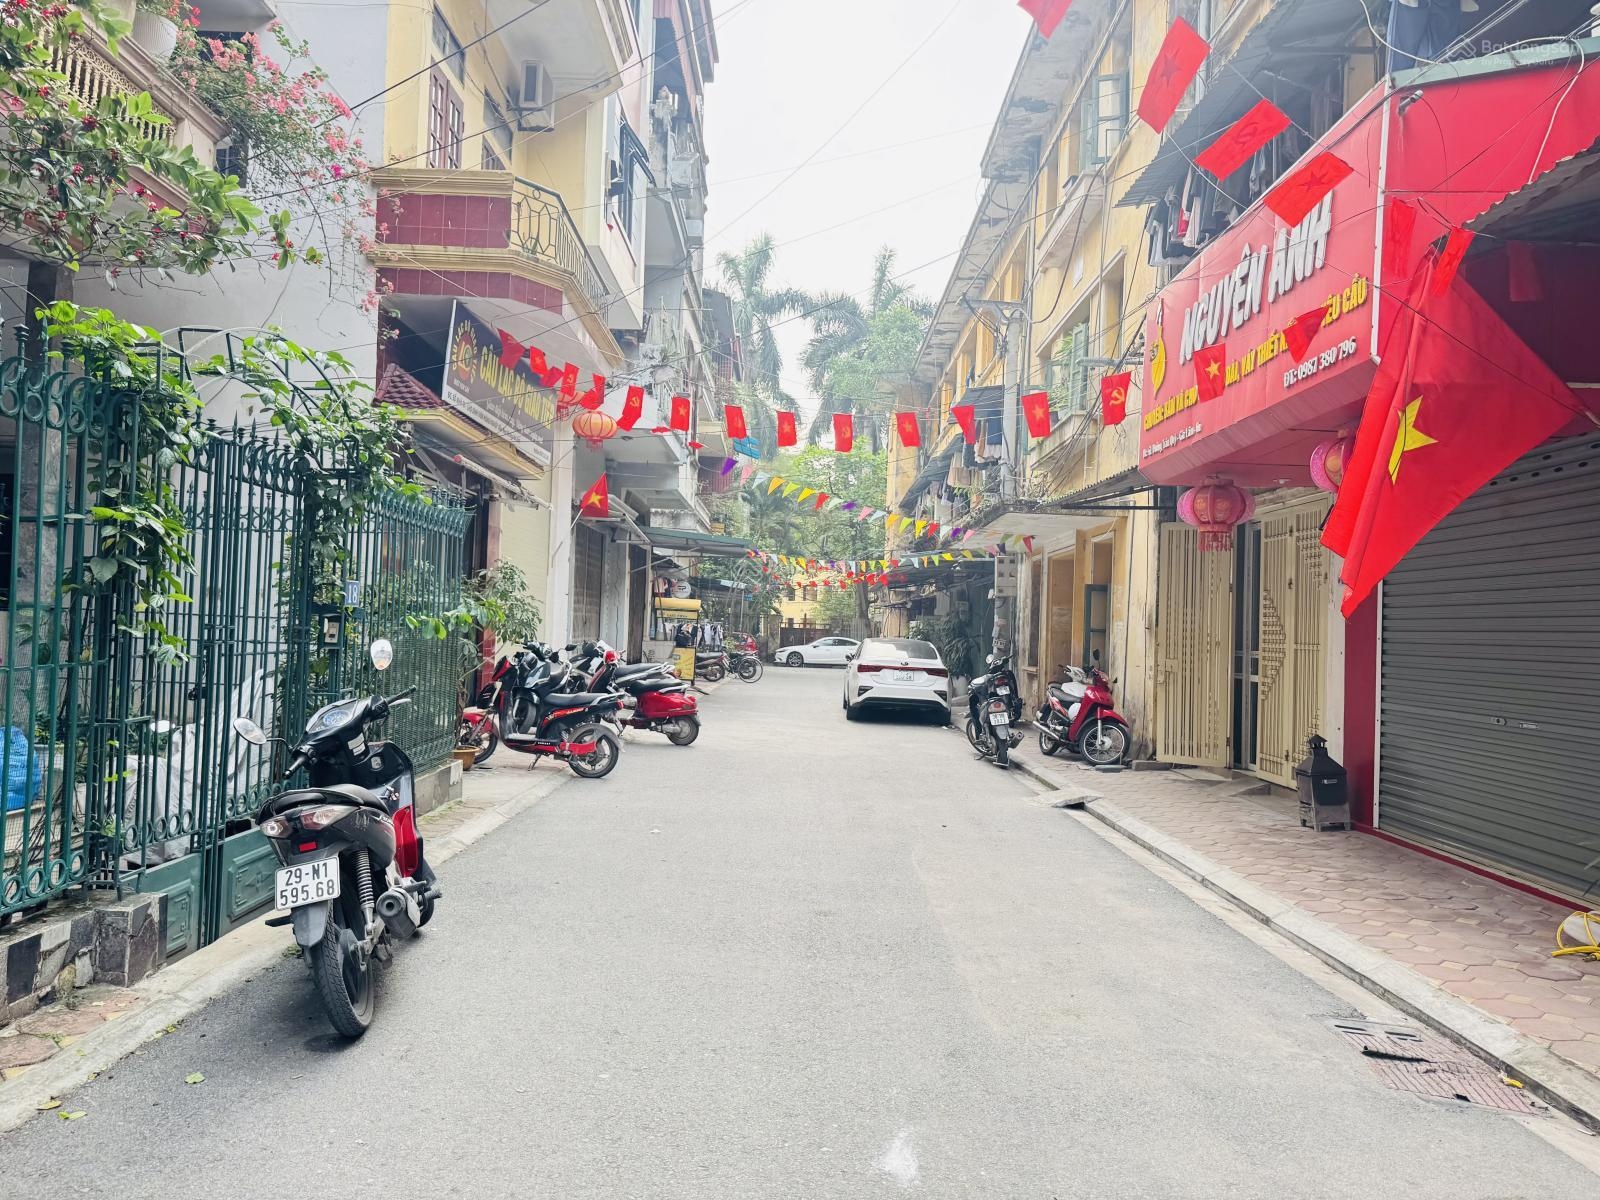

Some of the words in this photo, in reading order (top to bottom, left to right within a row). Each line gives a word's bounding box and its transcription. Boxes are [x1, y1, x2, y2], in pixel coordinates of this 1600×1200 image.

[1180, 243, 1268, 365] NGUYÊN
[1343, 273, 1367, 313] CẦU
[482, 345, 499, 388] CÂU
[1297, 356, 1318, 380] 0987
[1319, 346, 1338, 370] 380
[1338, 336, 1357, 360] 796
[348, 584, 358, 603] 18
[280, 879, 334, 906] 595.68
[286, 863, 328, 886] 29-N1
